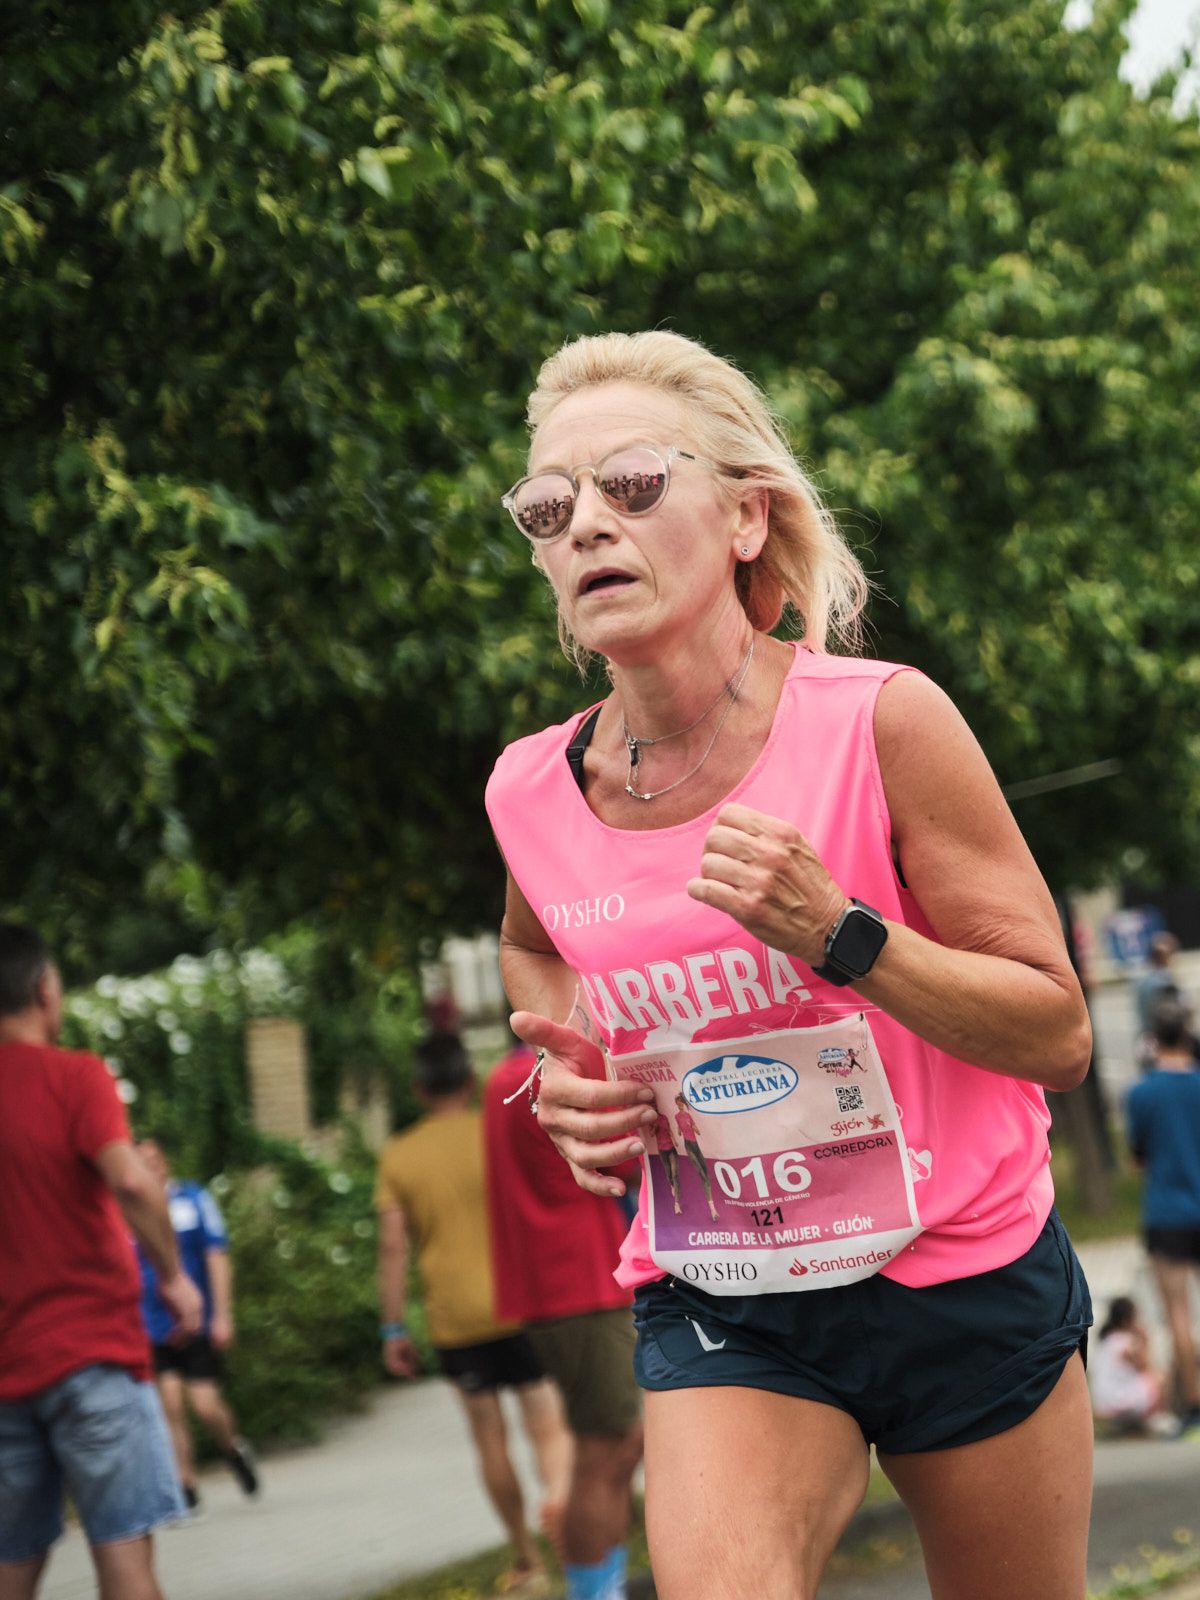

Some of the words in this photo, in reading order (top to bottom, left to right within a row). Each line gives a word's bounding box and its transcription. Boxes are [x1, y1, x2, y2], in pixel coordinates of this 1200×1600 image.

[543, 894, 625, 931] OYSHO
[630, 1068, 677, 1083] SUMA
[635, 1060, 671, 1071] DORSAL
[700, 1073, 737, 1085] CENTRAL
[742, 1067, 782, 1077] LECHERA
[813, 1136, 893, 1159] CORREDORA
[714, 1151, 812, 1199] 016
[751, 1206, 784, 1227] 121
[688, 1232, 739, 1246] CARRERA
[742, 1232, 757, 1246] DE
[757, 1233, 772, 1246] LA
[775, 1225, 822, 1244] MUJER
[832, 1214, 873, 1235] GIJÓN
[682, 1262, 758, 1282] OYSHO
[809, 1249, 893, 1274] Santander
